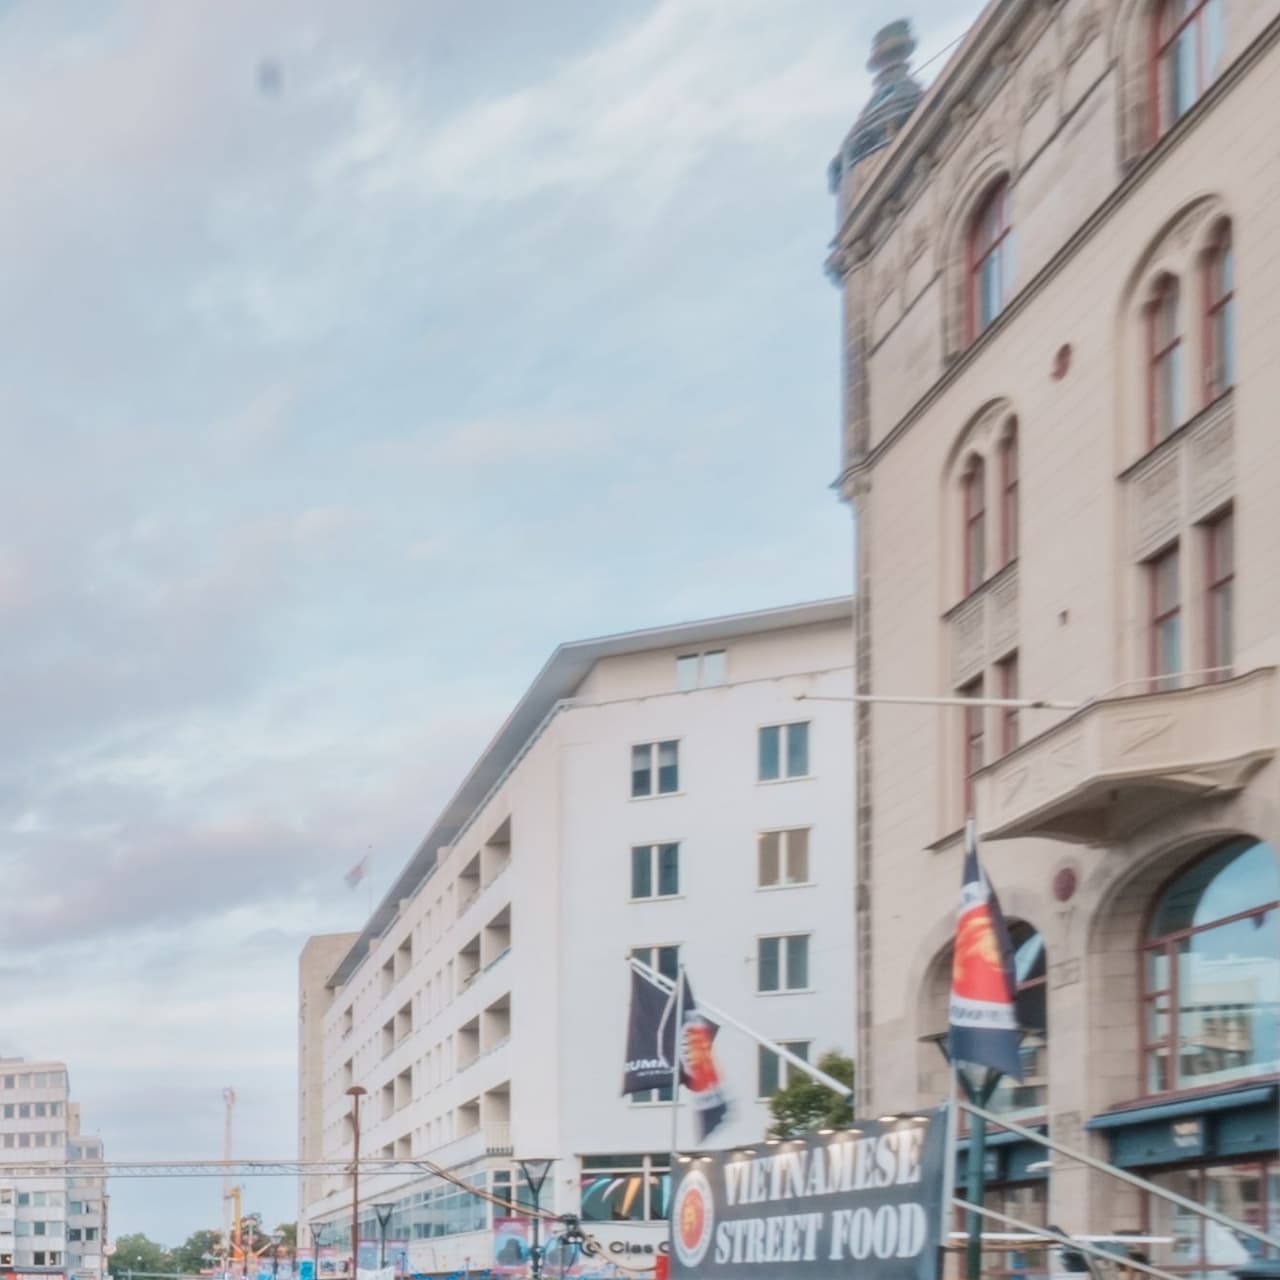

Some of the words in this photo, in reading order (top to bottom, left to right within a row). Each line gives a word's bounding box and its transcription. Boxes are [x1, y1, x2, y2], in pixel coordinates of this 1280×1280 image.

[724, 1127, 925, 1206] VIETNAMESE
[714, 1212, 824, 1264] STREET
[829, 1202, 927, 1260] FOOD
